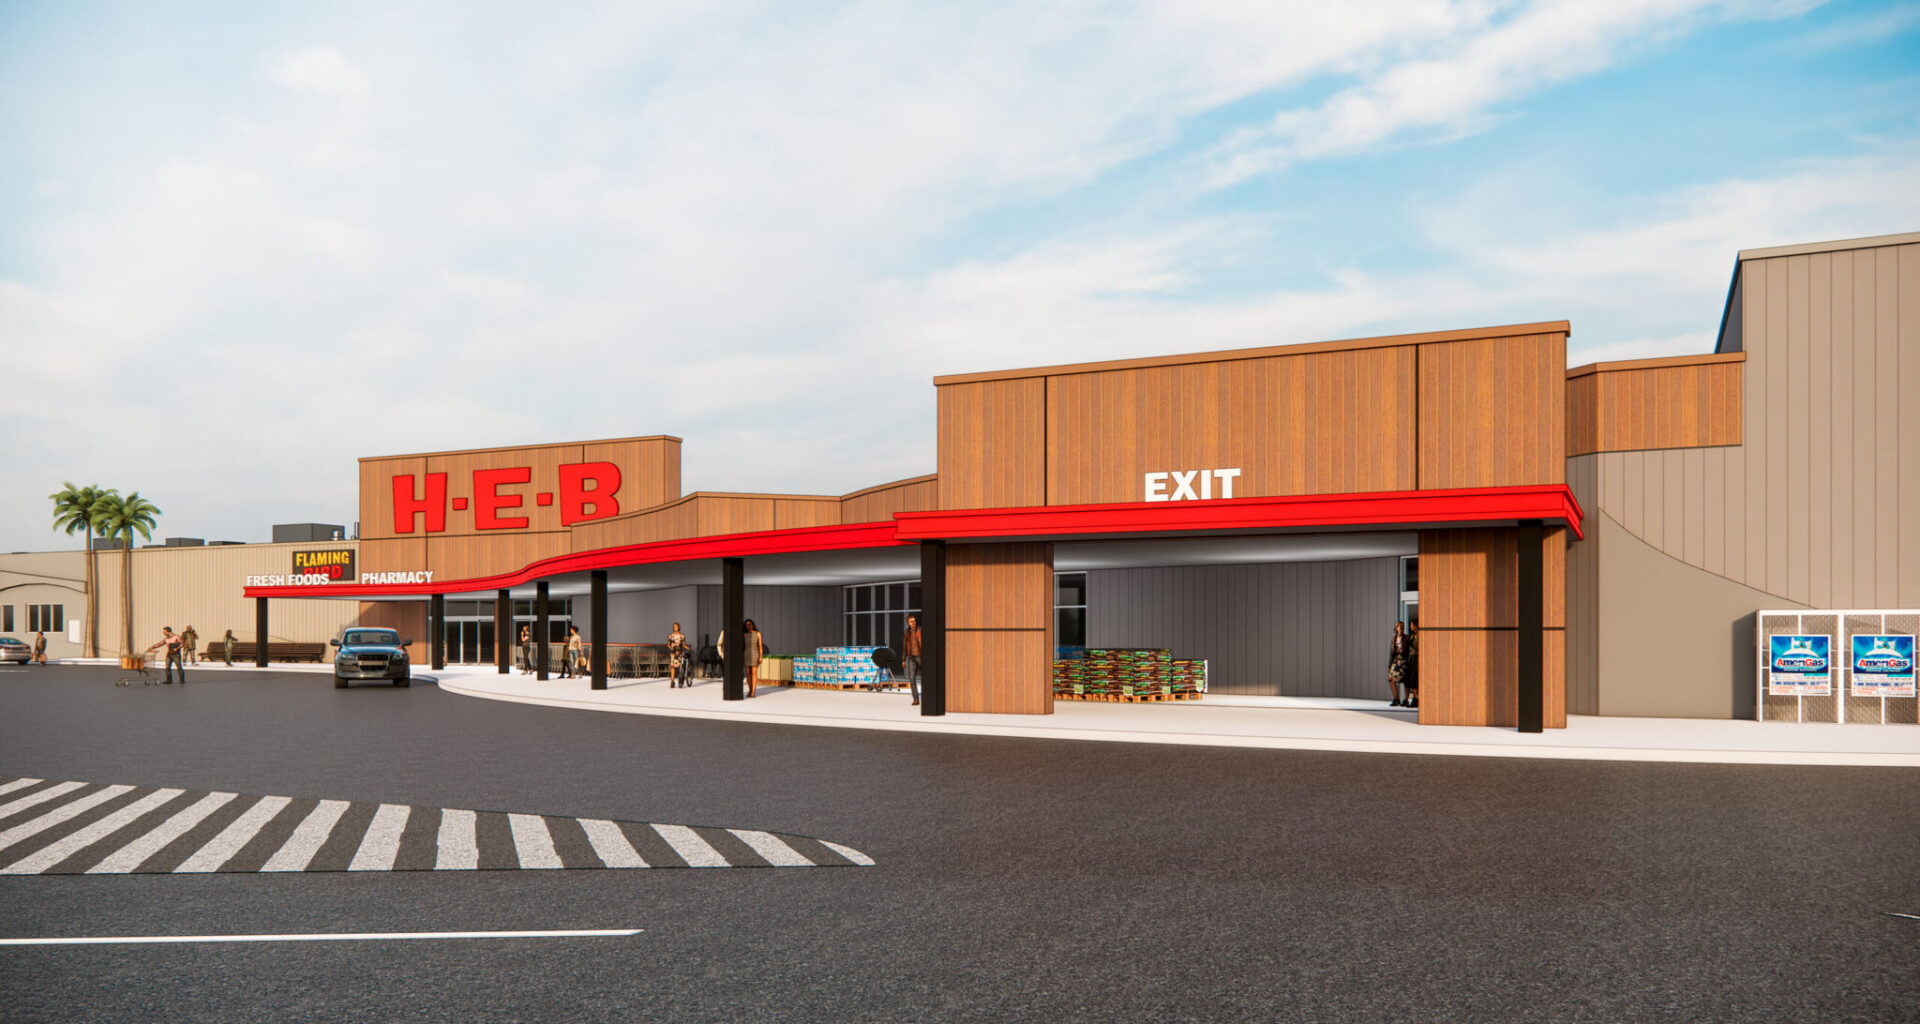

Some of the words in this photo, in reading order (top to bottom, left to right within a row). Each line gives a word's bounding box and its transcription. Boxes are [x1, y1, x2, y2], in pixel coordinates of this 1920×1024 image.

[1145, 468, 1241, 503] EXIT
[392, 461, 622, 534] H-E-B
[295, 551, 350, 567] FLAMING
[246, 574, 285, 587] FRESH
[288, 573, 330, 586] FOODS
[361, 570, 433, 585] PHARMACY
